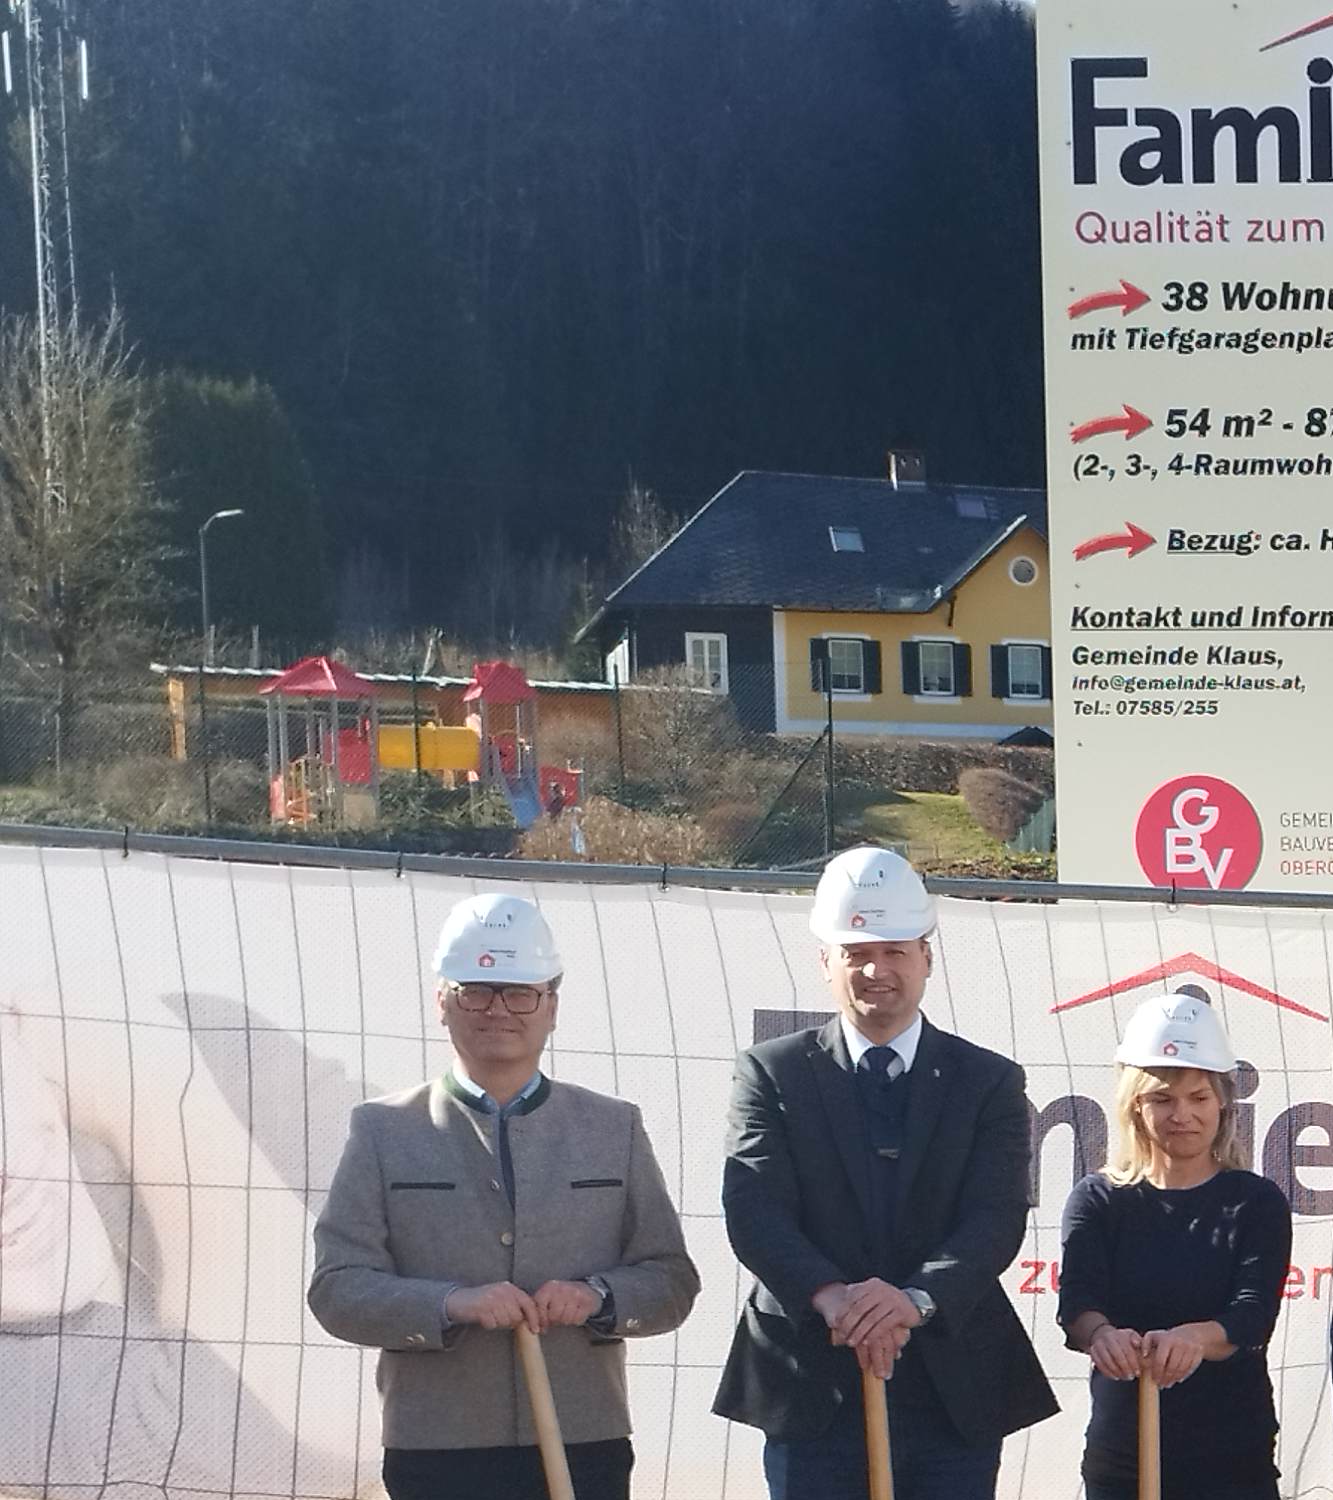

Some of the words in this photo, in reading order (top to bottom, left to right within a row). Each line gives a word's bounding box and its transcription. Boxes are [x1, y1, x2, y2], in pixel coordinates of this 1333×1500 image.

[1075, 209, 1230, 243] Qualität
[1246, 215, 1325, 243] zum
[1161, 281, 1209, 313] 38
[1070, 328, 1116, 351] mit
[1164, 407, 1211, 438] 54
[1222, 407, 1273, 438] m²
[1072, 453, 1116, 482] (2-,
[1124, 453, 1158, 481] 3-,
[1167, 528, 1263, 556] Bezug:
[1269, 532, 1311, 552] ca.
[1071, 606, 1182, 629] Kontakt
[1190, 606, 1243, 629] und
[1071, 646, 1200, 667] Gemeinde
[1206, 646, 1285, 670] Klaus,
[1115, 700, 1219, 717] 07585/255
